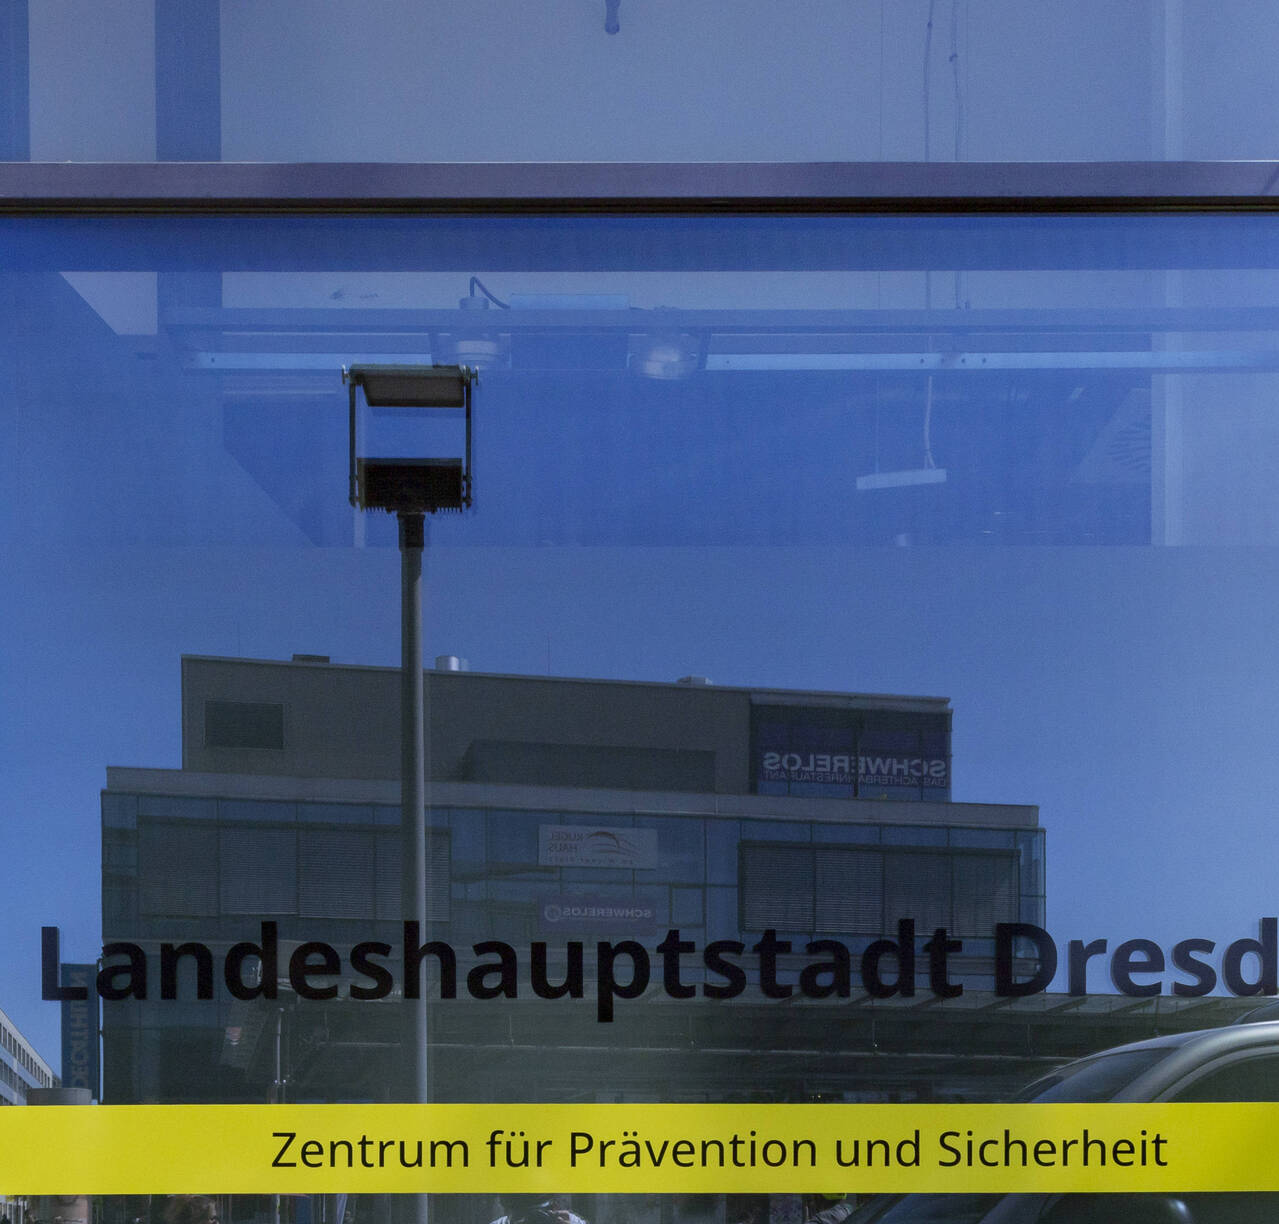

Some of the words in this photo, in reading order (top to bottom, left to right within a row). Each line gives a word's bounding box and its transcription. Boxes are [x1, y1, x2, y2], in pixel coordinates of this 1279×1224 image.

[41, 919, 964, 1023] Landeshauptstadt
[271, 1132, 470, 1168] Zentrum
[486, 1130, 553, 1168] für
[569, 1130, 817, 1168] Prävention
[835, 1129, 922, 1168] und
[938, 1128, 1169, 1168] Sicherheit
